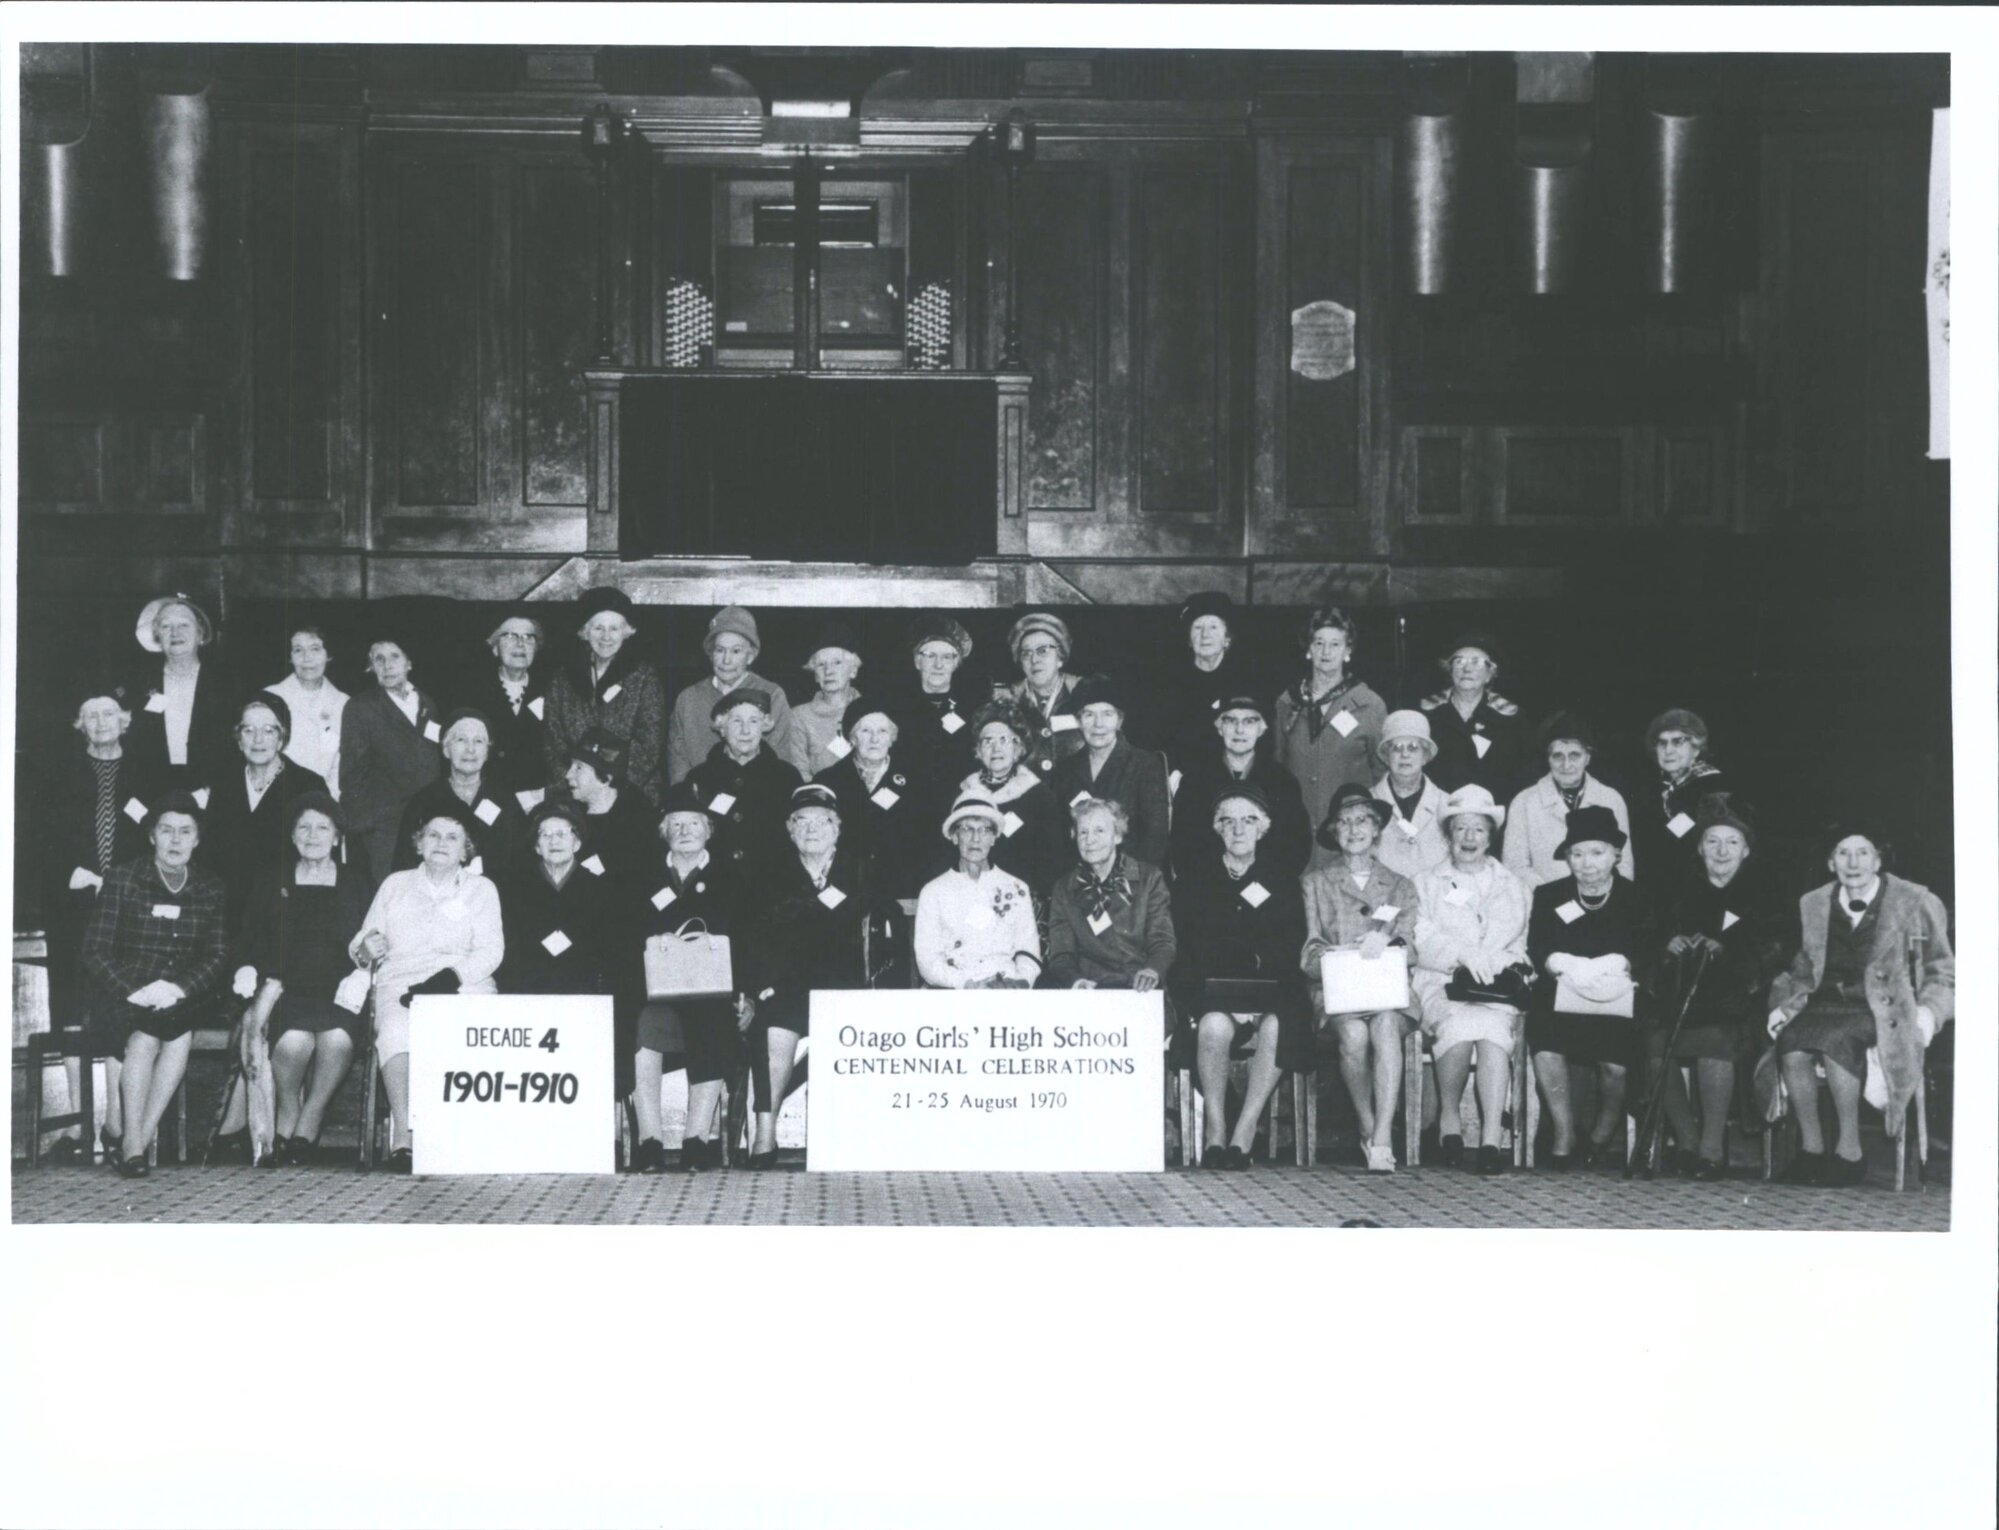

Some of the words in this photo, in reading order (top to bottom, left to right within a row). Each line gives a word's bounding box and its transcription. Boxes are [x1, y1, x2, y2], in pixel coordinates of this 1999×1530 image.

[466, 1026, 533, 1049] DECADE
[537, 1027, 561, 1054] 4
[838, 1025, 907, 1053] Otago
[916, 1025, 980, 1049] Girls'
[989, 1026, 1043, 1052] High
[1053, 1025, 1129, 1049] School
[833, 1058, 968, 1075] CENTENNIAL
[981, 1058, 1135, 1075] CELEBRATIONS
[442, 1070, 579, 1105] 1901-1910
[959, 1093, 1017, 1113] August
[1031, 1092, 1067, 1109] 1970
